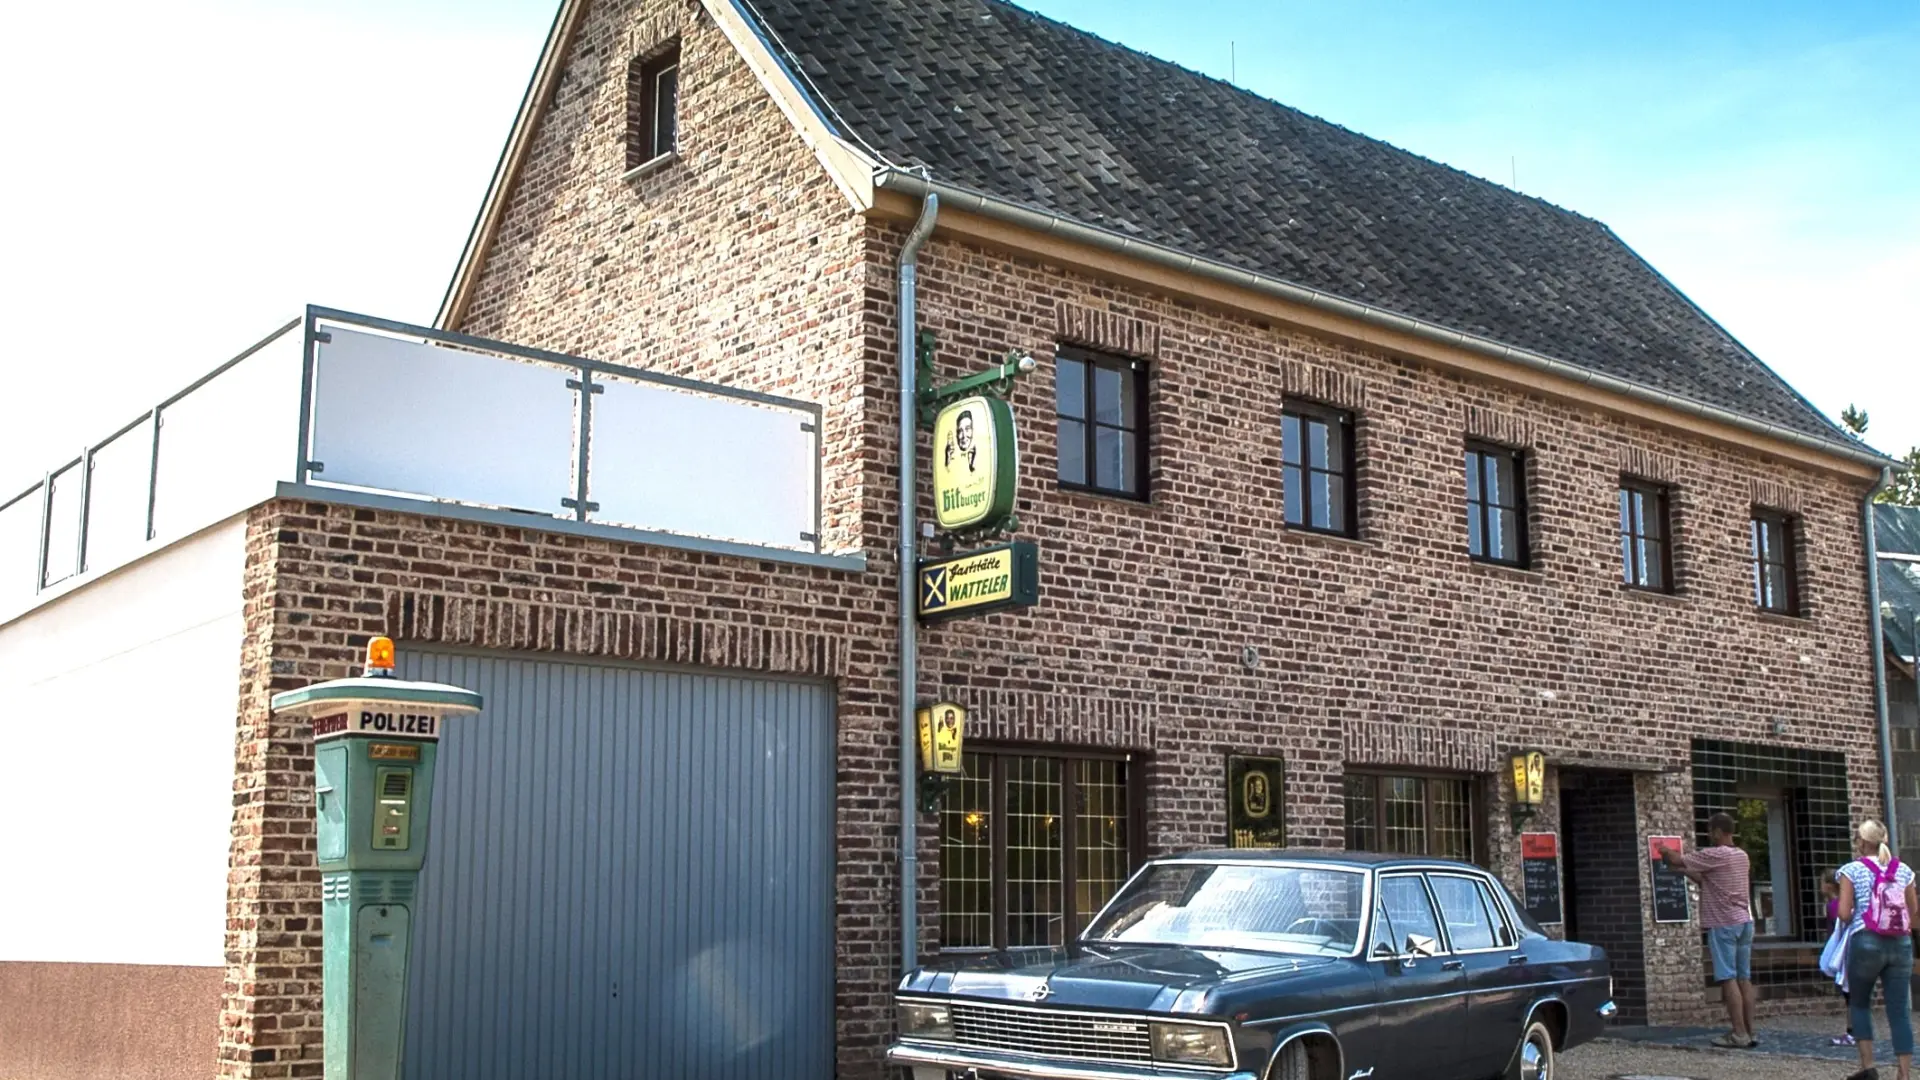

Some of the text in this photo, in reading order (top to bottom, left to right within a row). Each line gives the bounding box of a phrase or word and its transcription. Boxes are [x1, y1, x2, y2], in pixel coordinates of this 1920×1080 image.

[943, 487, 985, 512] Bitburger
[949, 557, 1000, 581] Gaststätte
[950, 574, 1008, 601] WATTELER
[360, 711, 435, 734] POLIZEI
